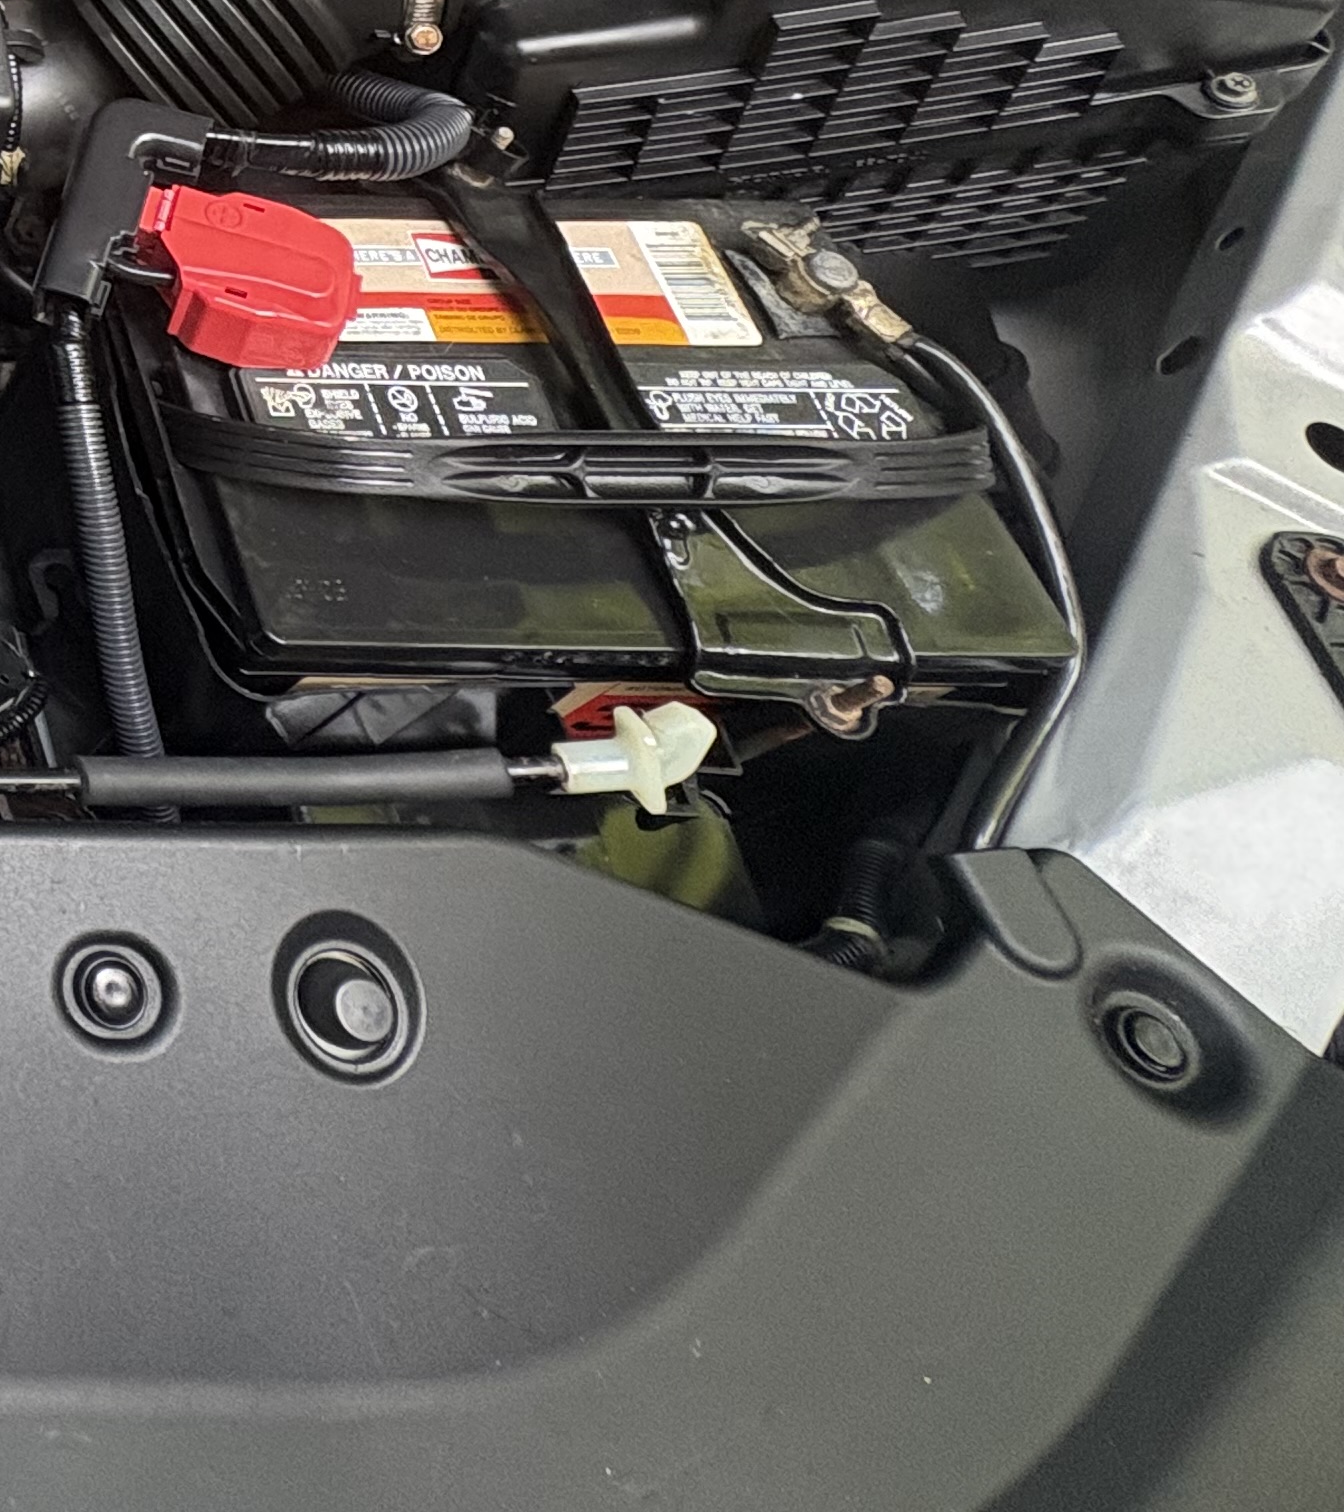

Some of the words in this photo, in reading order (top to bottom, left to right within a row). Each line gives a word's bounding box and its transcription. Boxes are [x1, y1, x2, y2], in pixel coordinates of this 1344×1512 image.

[424, 247, 485, 265] CHAM
[574, 251, 604, 264] ERE
[307, 361, 390, 380] DANGER
[410, 364, 486, 381] POISON
[399, 412, 419, 423] NO
